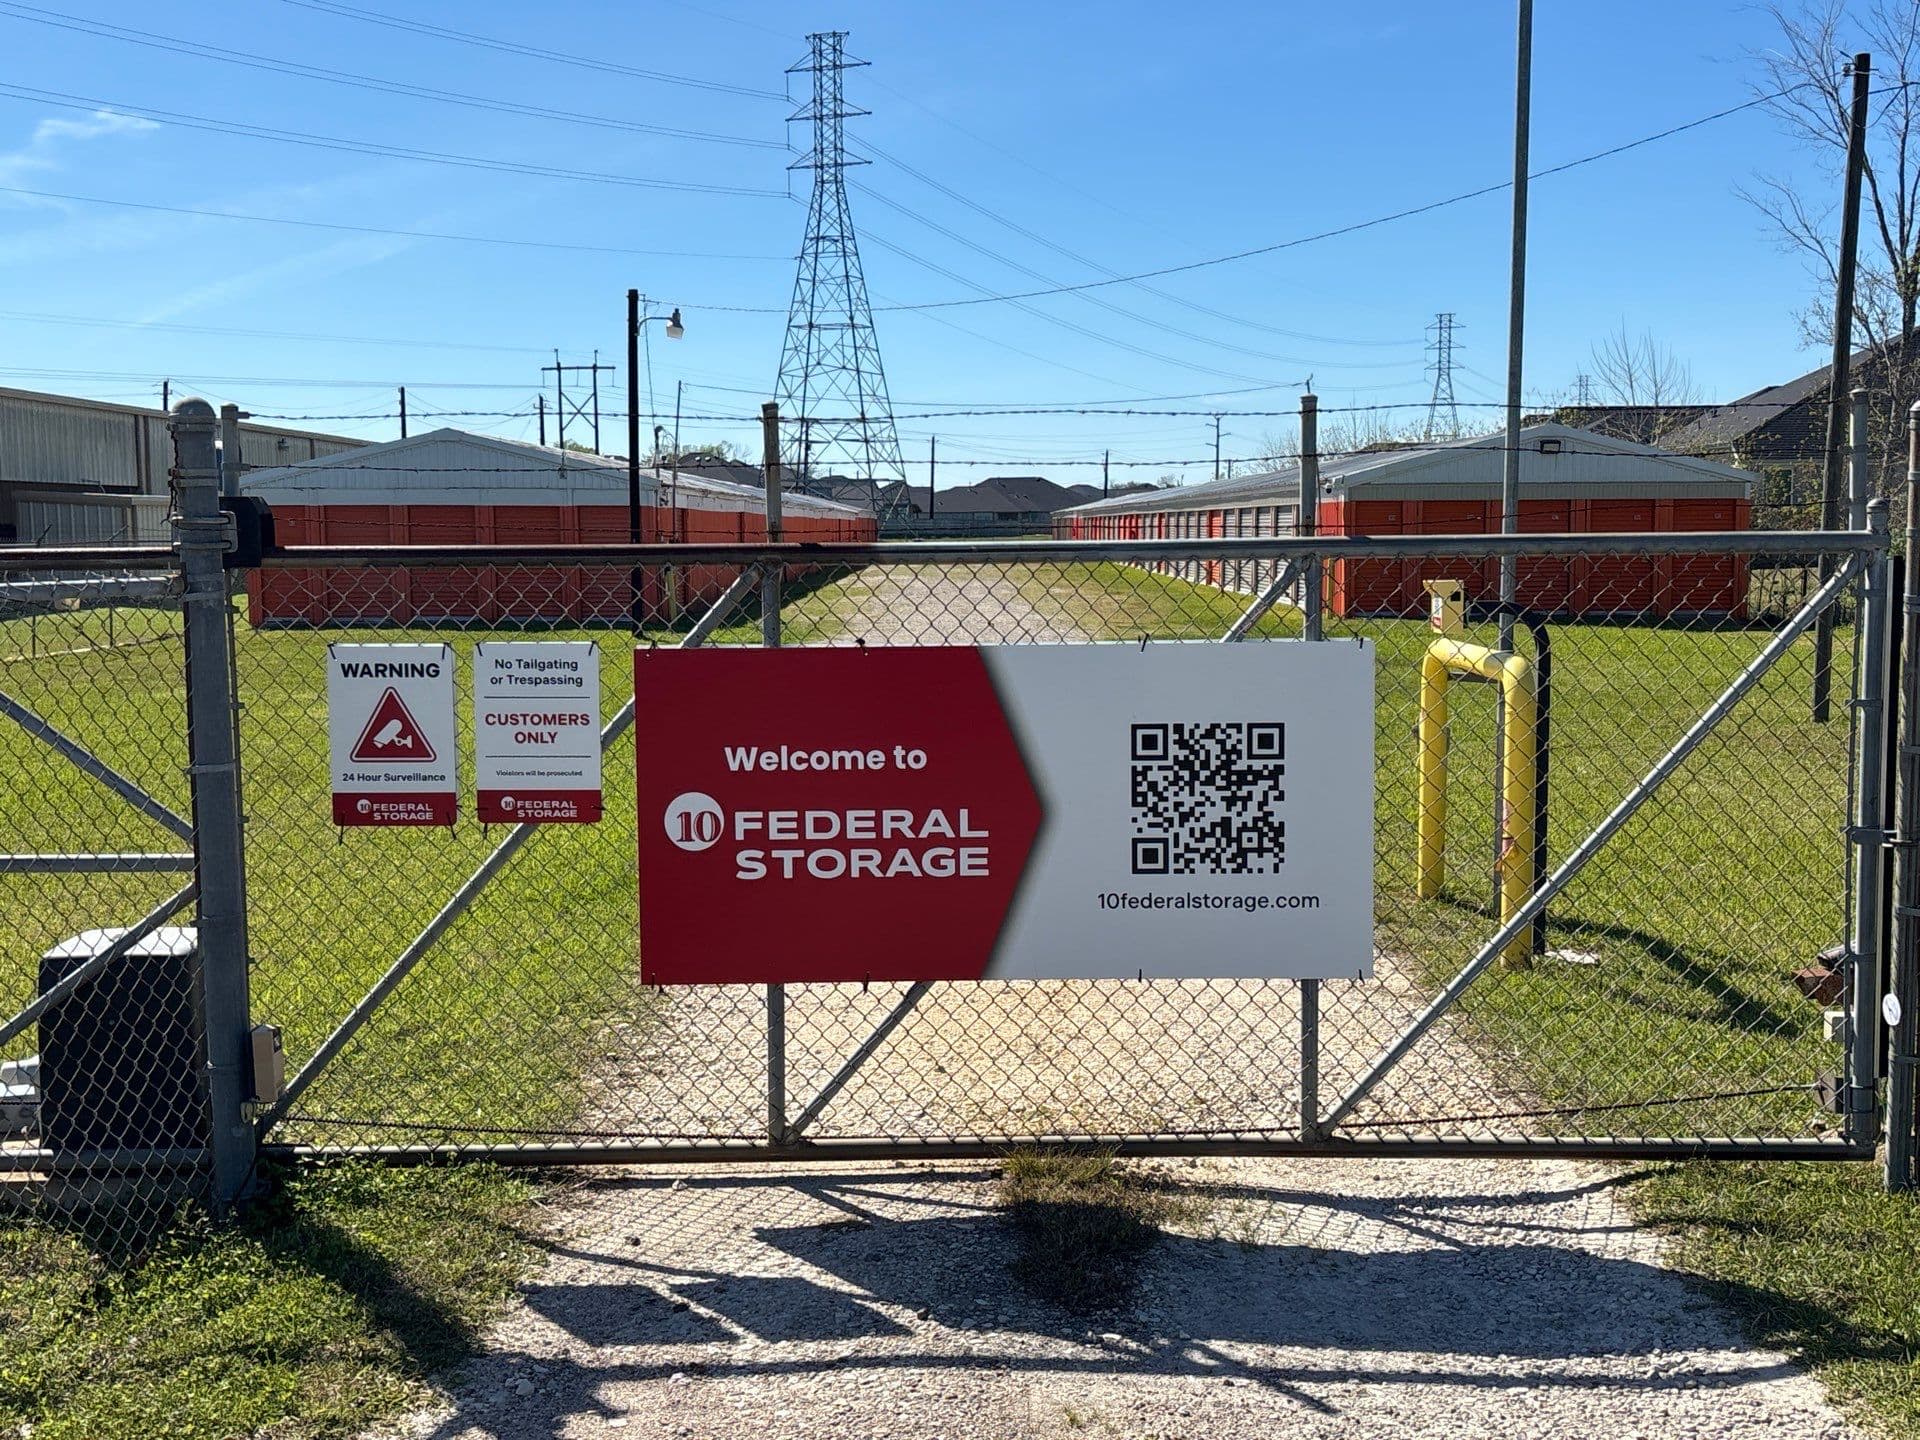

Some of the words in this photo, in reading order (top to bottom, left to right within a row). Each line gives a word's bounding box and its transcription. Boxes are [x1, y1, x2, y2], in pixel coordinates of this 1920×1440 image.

[341, 663, 440, 678] WARNING
[495, 659, 513, 669] No
[516, 659, 579, 672] Tailgating
[490, 676, 504, 685] or
[507, 674, 583, 688] Trespassing
[485, 713, 590, 726] CUSTOMERS
[514, 731, 558, 744] ONLY
[724, 745, 885, 771] Welcome
[893, 745, 928, 770] to
[342, 773, 356, 782] 24
[357, 773, 382, 782] Hour
[384, 773, 446, 782] Surveillance
[373, 803, 433, 812] FEDERAL
[517, 800, 577, 809] FEDERAL
[373, 812, 434, 821] STORAGE
[517, 809, 577, 818] STORAGE
[676, 810, 722, 843] 10
[734, 808, 990, 841] FEDERAL
[735, 846, 990, 880] STORAGE
[1097, 892, 1320, 912] 10federalstorage.com
